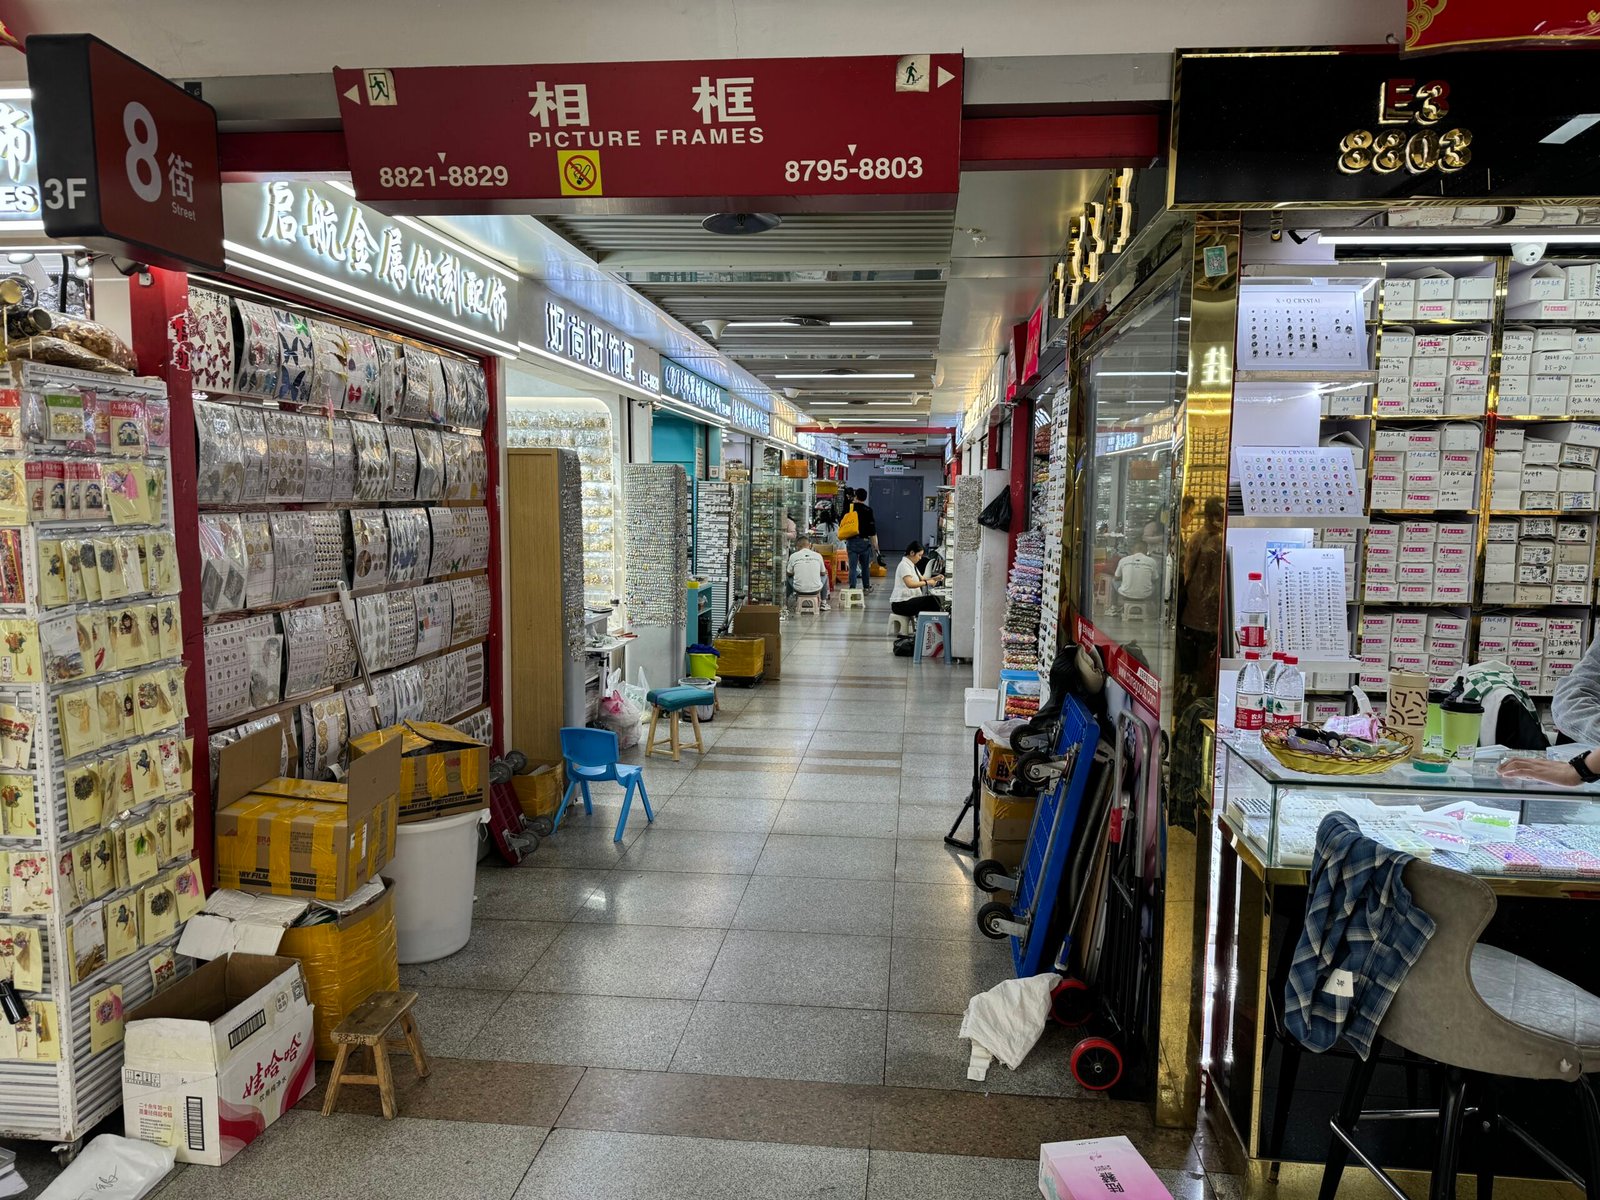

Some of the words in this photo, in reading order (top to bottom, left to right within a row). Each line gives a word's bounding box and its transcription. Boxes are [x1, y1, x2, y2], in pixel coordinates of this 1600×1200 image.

[528, 76, 756, 127] 相框
[1378, 78, 1451, 125] E3
[528, 129, 641, 149] PICTURE
[655, 127, 765, 146] FRAMES
[1337, 128, 1473, 174] 8803
[379, 165, 509, 188] 8821-8829
[784, 156, 924, 183] 8795-8803
[44, 178, 86, 210] 3F
[172, 201, 196, 222] Street
[242, 1034, 302, 1099] 娃哈哈
